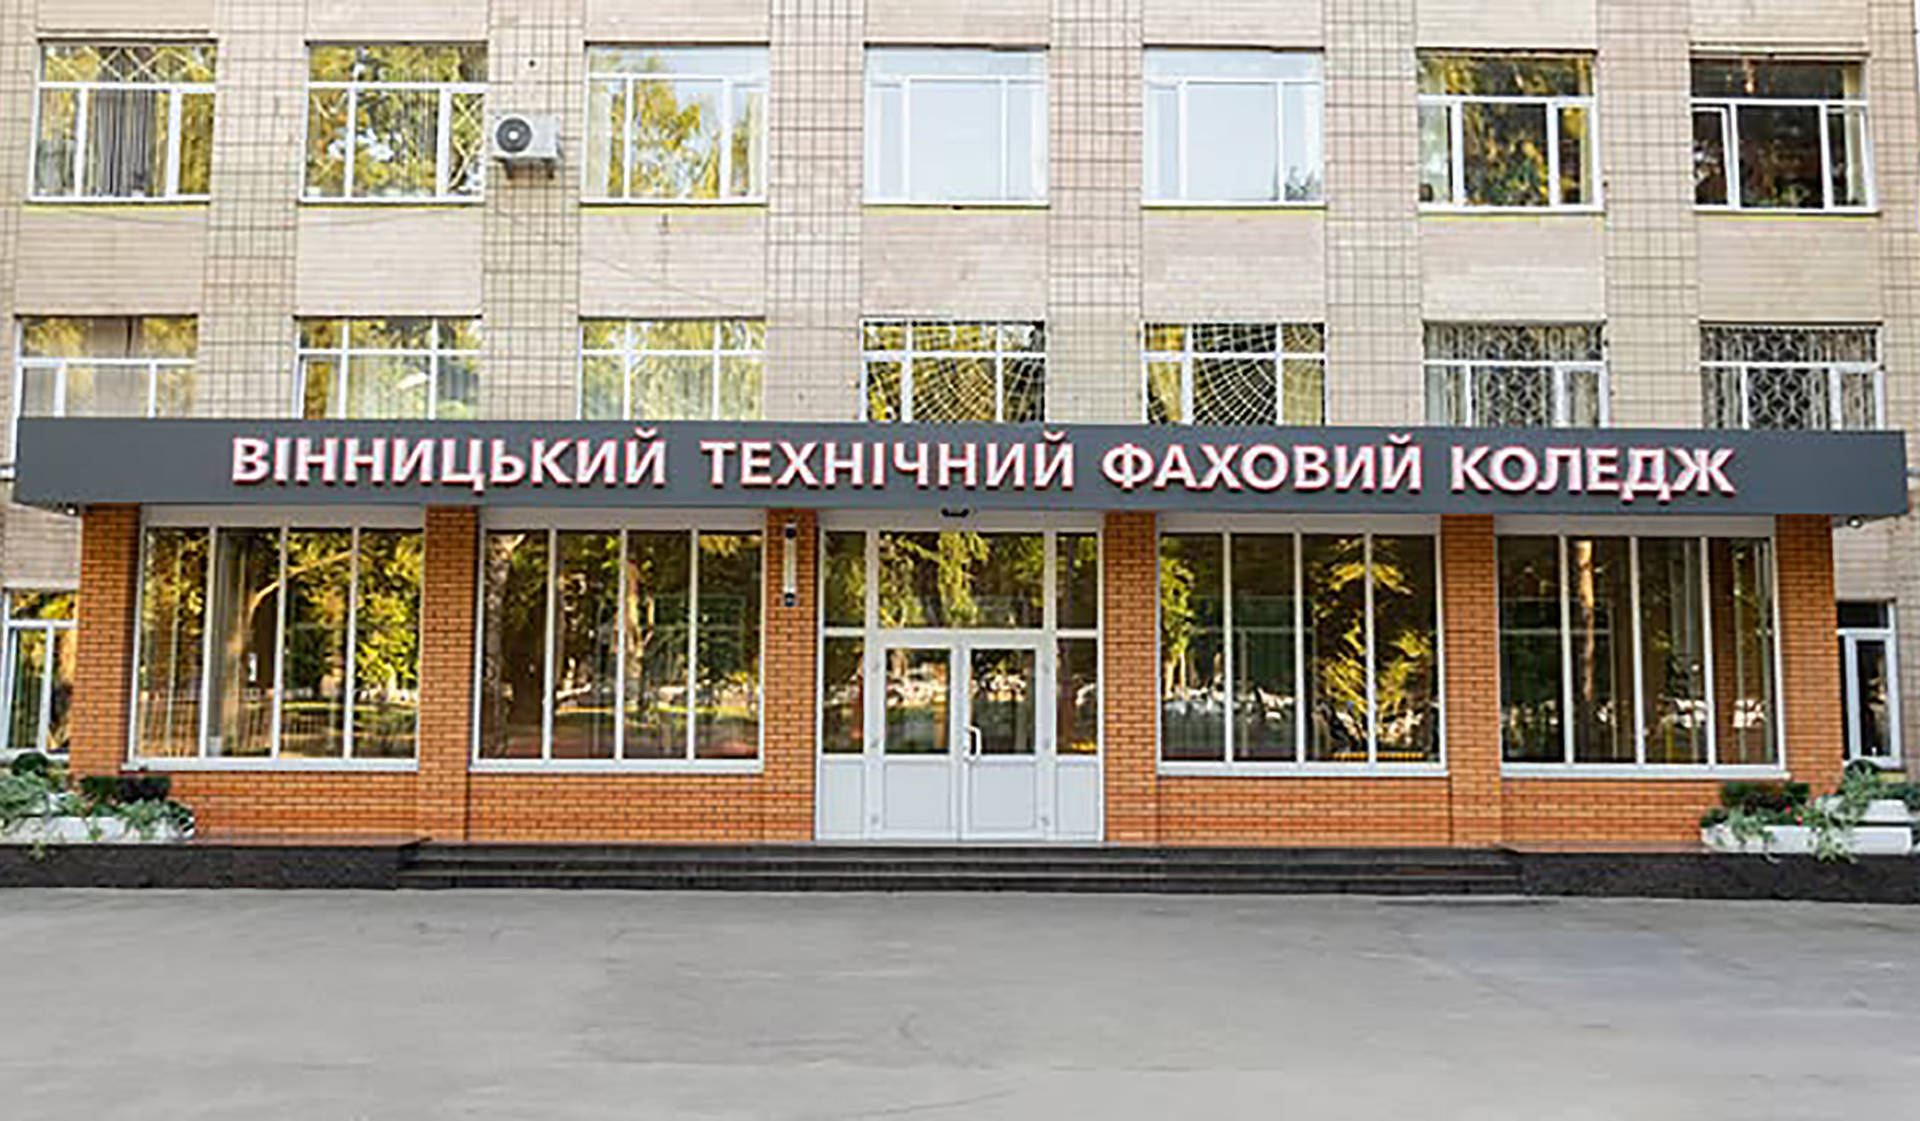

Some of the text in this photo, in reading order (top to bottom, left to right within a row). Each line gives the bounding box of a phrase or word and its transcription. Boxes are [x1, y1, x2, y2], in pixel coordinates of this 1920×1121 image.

[231, 427, 1736, 501] ВІННИЦЬКИЙ ТЕХНІЧНИЙ ФАХОВИЙ КОЛЕДЖ
